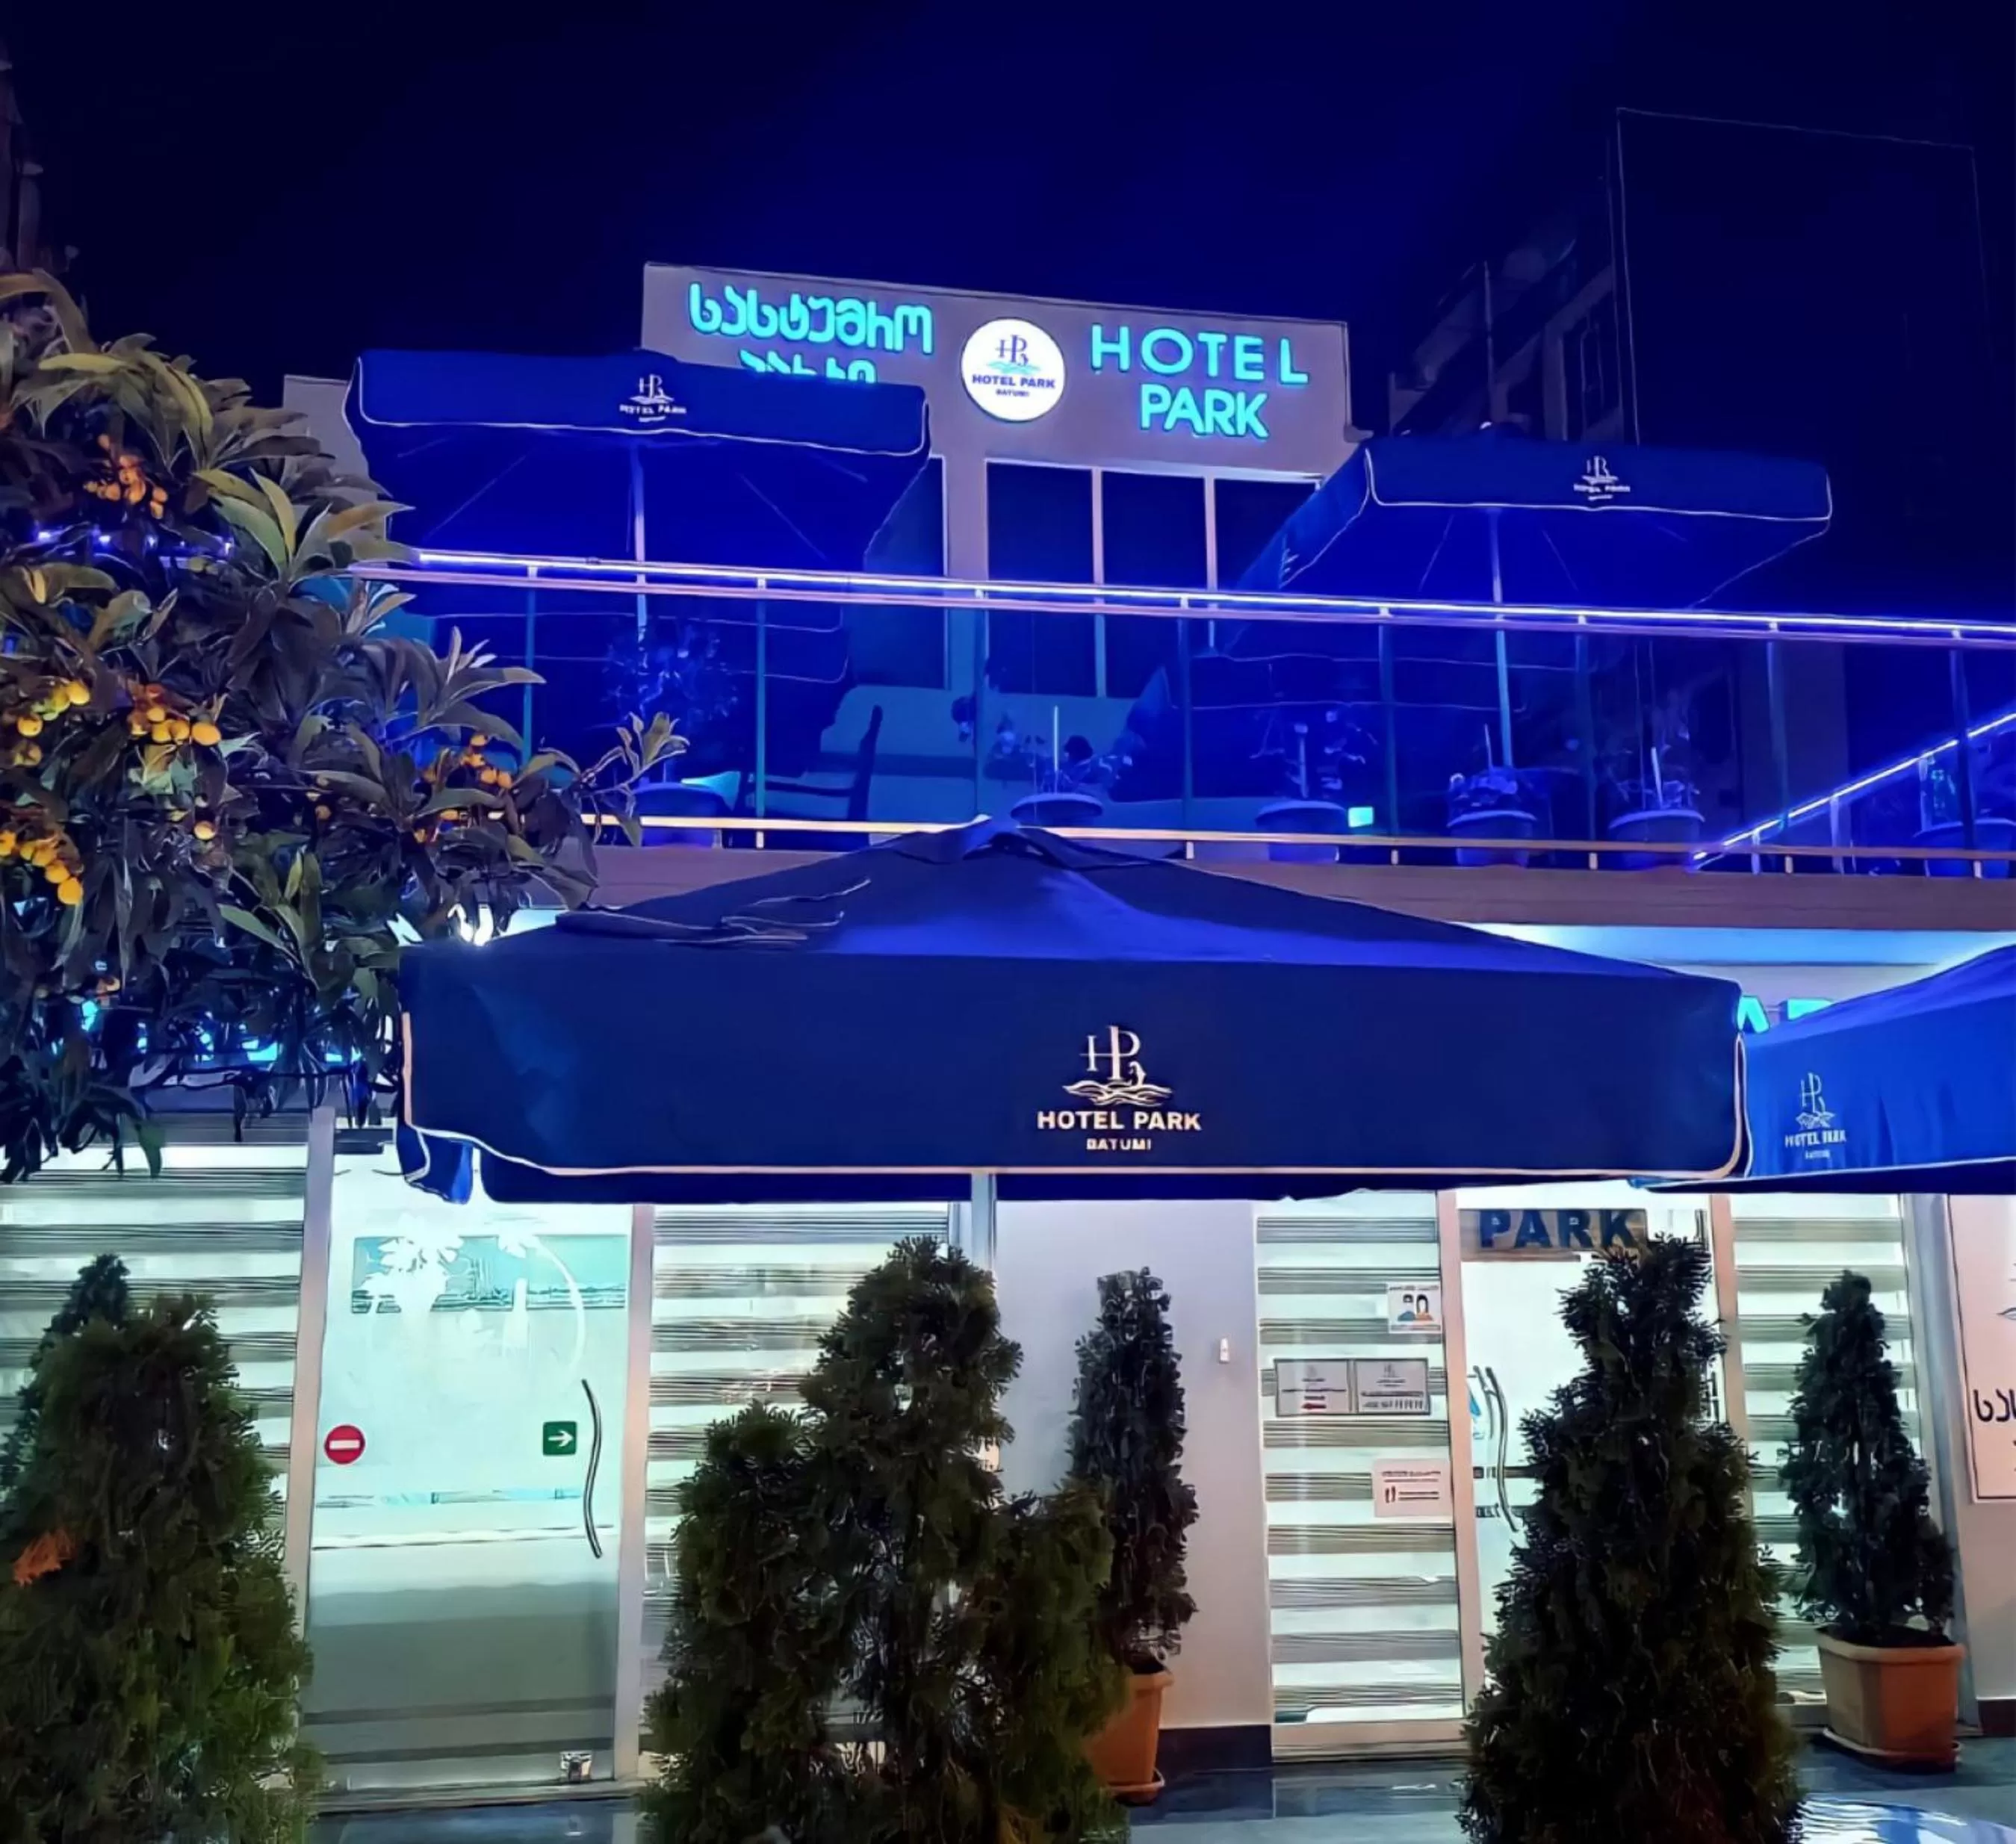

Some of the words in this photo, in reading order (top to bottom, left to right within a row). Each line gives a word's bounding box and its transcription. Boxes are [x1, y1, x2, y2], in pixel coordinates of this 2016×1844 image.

[689, 282, 933, 355] სასტუმრო
[1090, 322, 1309, 385] HOTEL
[972, 374, 1016, 387] HOTEL
[1020, 376, 1055, 388] PARK
[1139, 382, 1270, 439] PARK
[1037, 1111, 1125, 1130] HOTEL
[1133, 1111, 1203, 1131] PARK
[1085, 1137, 1152, 1150] BATUMI
[1479, 1208, 1636, 1249] PARK
